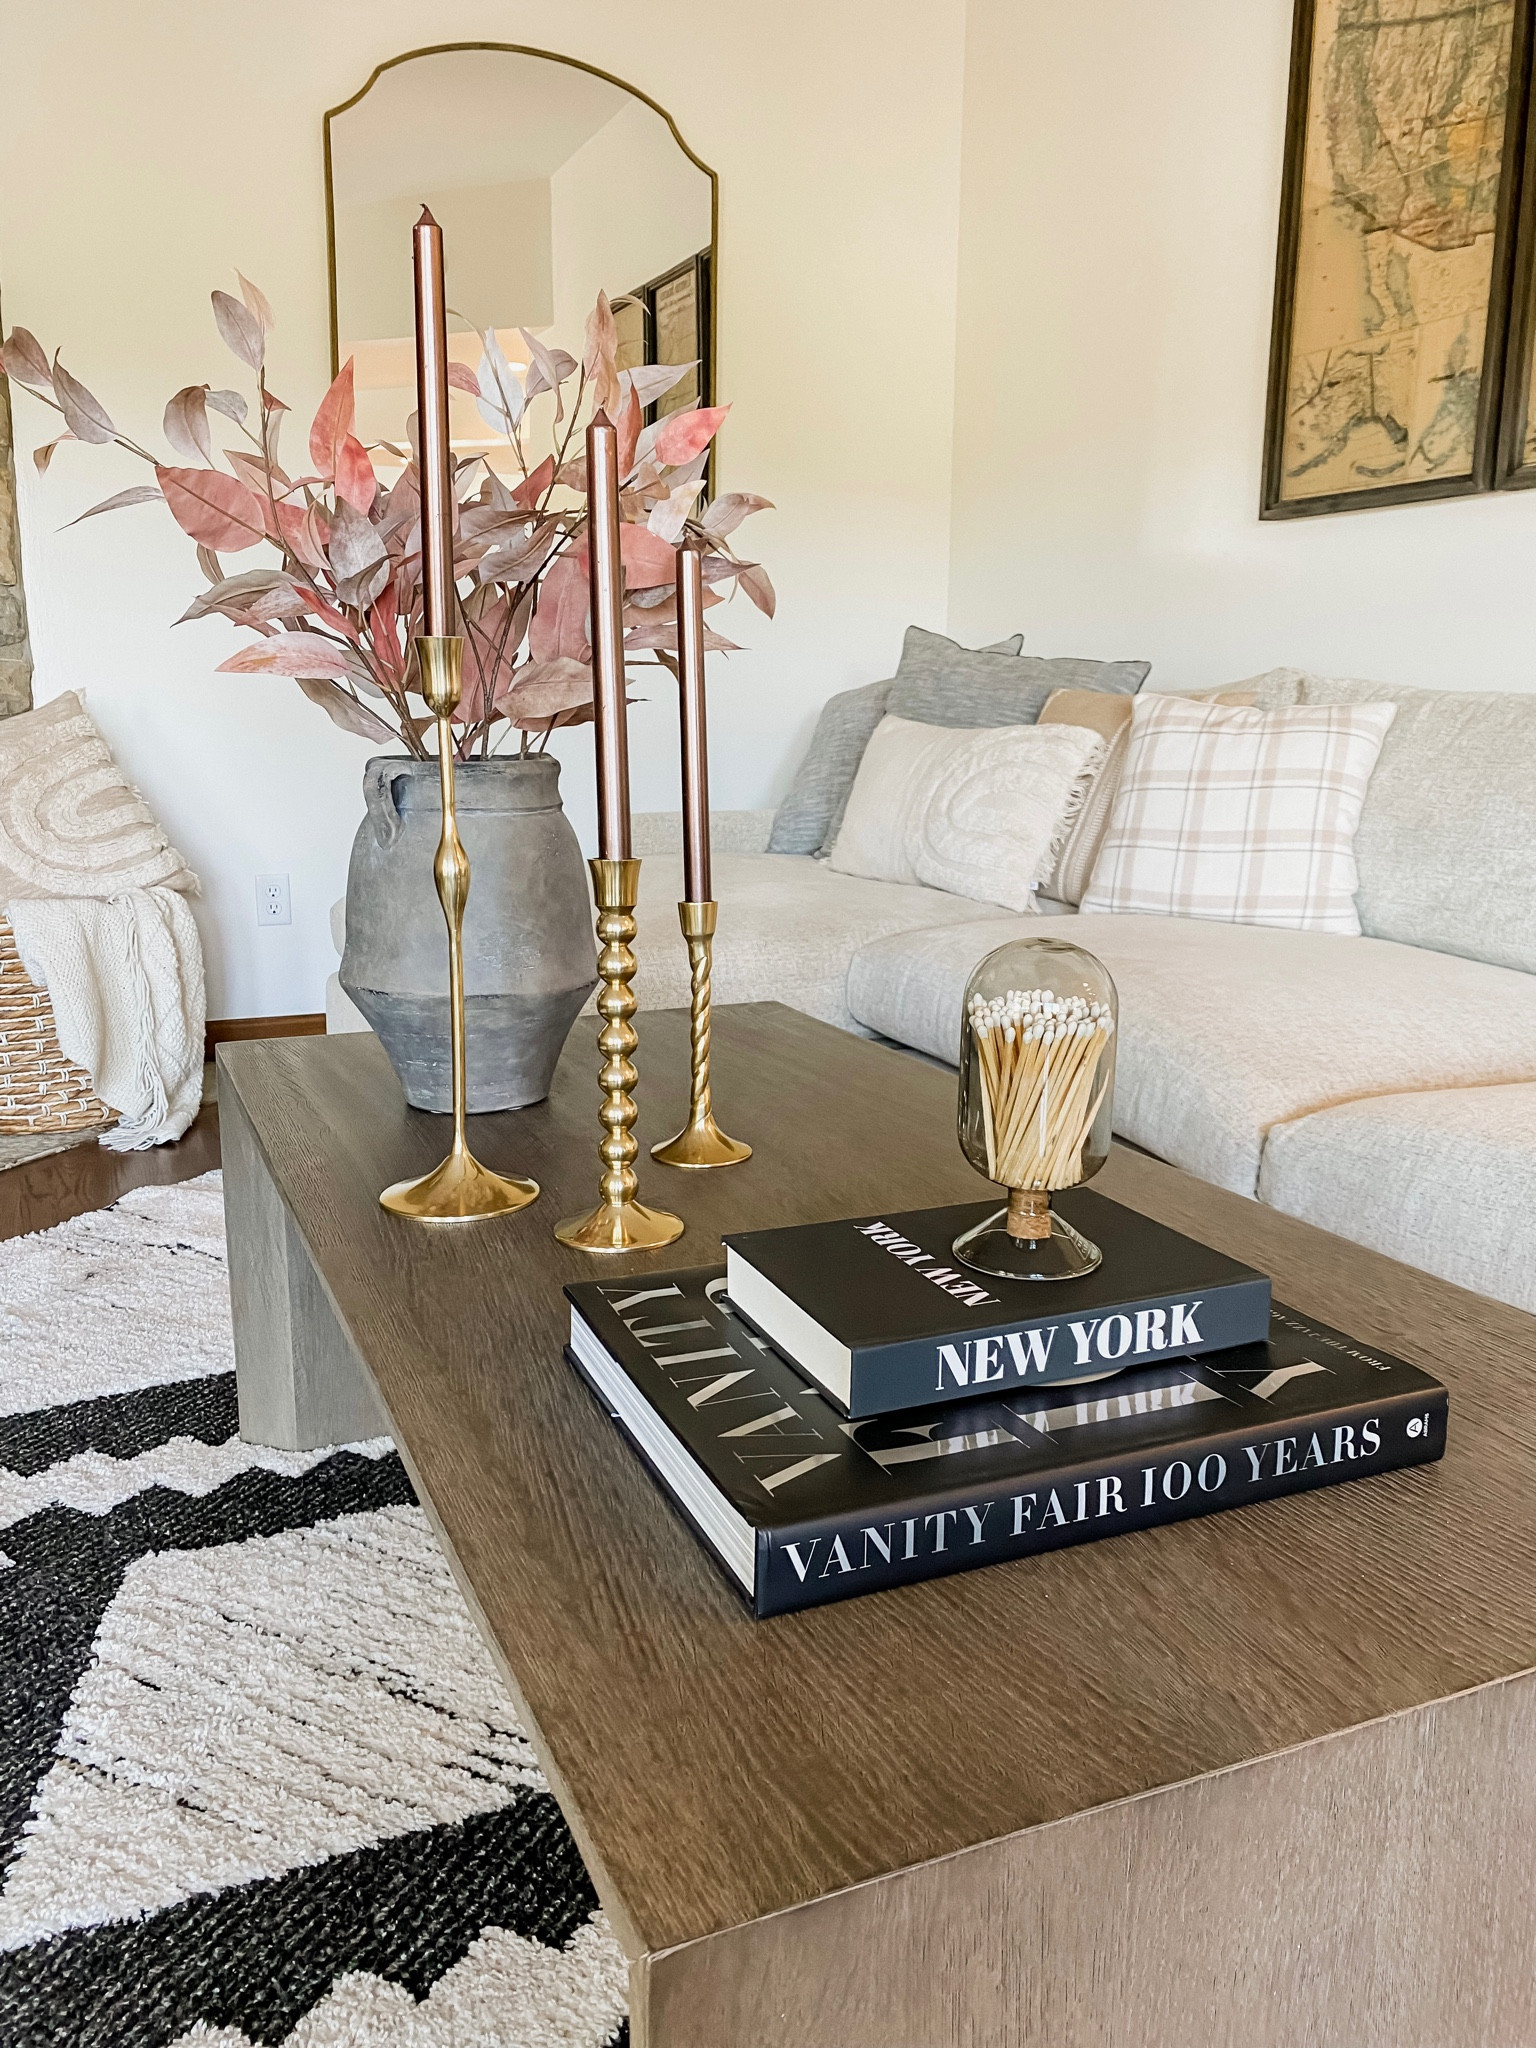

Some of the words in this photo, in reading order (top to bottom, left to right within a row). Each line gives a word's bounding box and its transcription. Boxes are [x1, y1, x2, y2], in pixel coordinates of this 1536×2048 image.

[853, 1221, 935, 1266] YORK
[914, 1267, 1001, 1307] NEW
[597, 1283, 842, 1497] VANITY
[935, 1326, 1059, 1391] NEW
[1067, 1301, 1204, 1365] YORK
[780, 1501, 995, 1583] VANITY
[1009, 1476, 1128, 1537] FAIR
[1140, 1453, 1227, 1507] 100
[1241, 1418, 1381, 1482] YEARS
